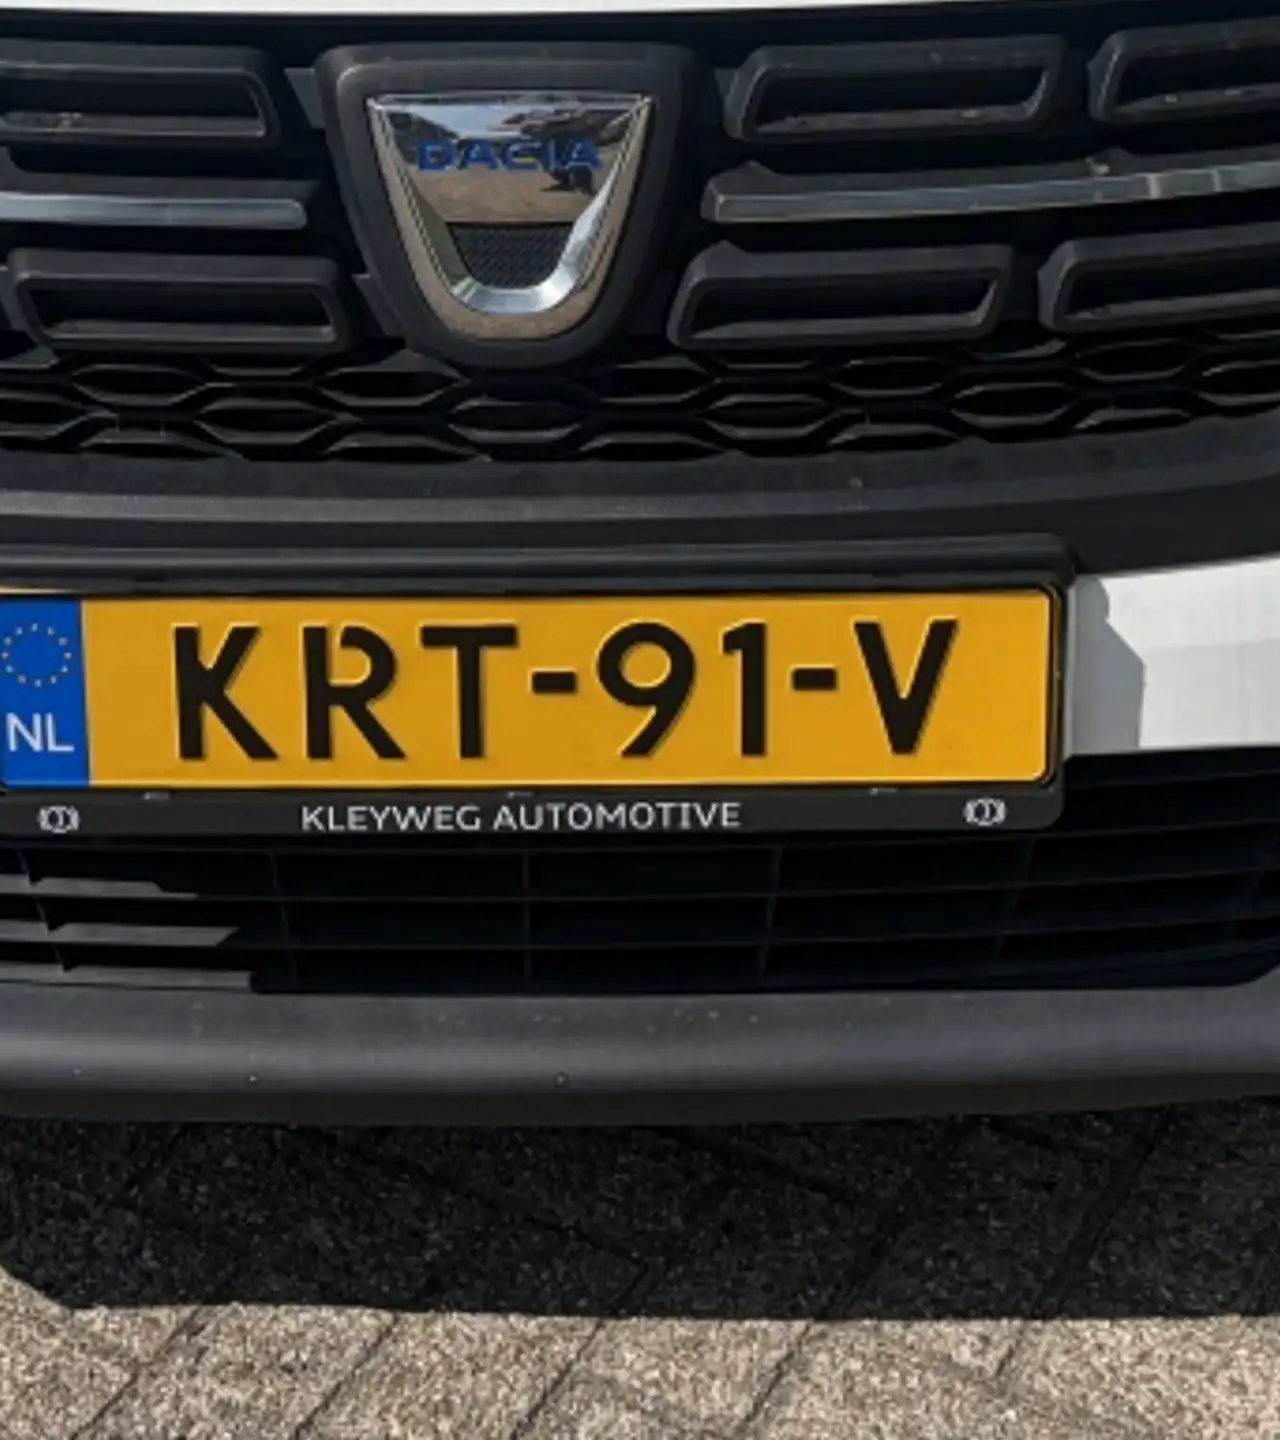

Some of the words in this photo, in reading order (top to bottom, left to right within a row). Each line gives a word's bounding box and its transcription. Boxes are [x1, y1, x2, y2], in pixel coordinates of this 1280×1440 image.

[418, 139, 604, 173] DACIA
[6, 712, 75, 753] NL
[173, 618, 959, 762] KRT-91-V
[300, 804, 481, 832] KLEYWEG
[492, 801, 742, 831] AUTOMOTIVE
